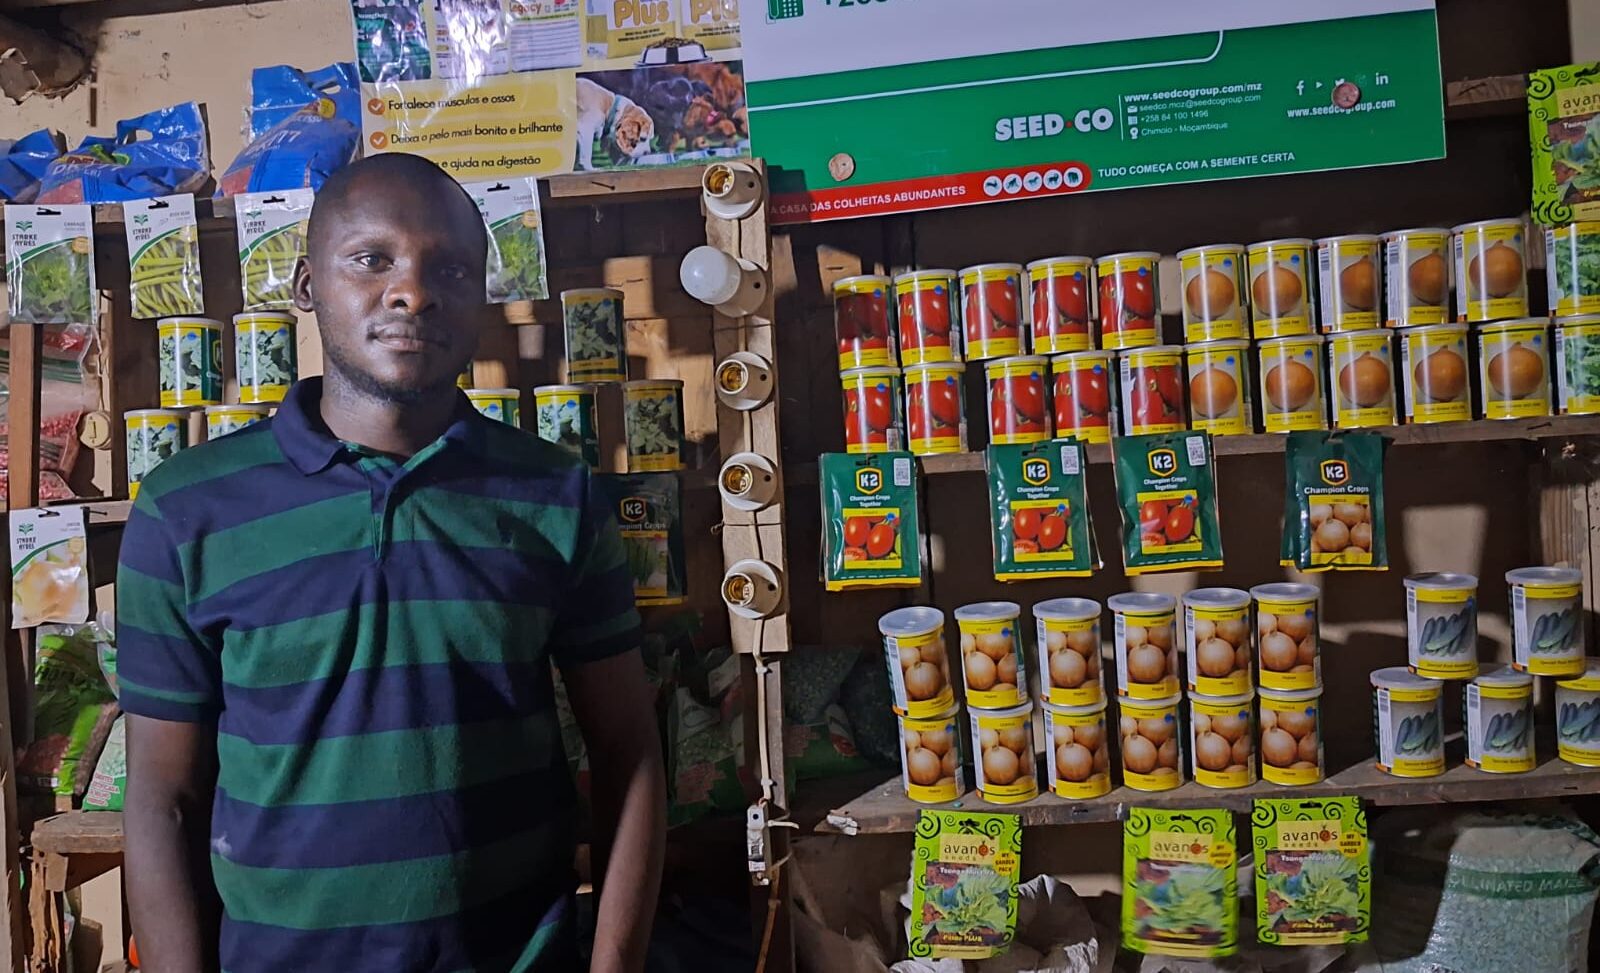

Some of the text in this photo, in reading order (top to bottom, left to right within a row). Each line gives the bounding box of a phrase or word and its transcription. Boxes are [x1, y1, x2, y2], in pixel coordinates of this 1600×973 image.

[613, 0, 669, 28] Plus
[1124, 82, 1262, 103] www.seedcogroup.com/mz
[388, 97, 436, 111] Fortalece
[481, 96, 489, 104] e
[491, 94, 516, 103] ossos
[1563, 94, 1600, 110] avan
[391, 134, 420, 144] Deixa
[429, 129, 450, 144] pelo
[451, 129, 473, 139] mais
[475, 124, 508, 136] bonito
[509, 127, 517, 135] e
[518, 123, 563, 135] brilhante
[441, 160, 448, 168] e
[450, 157, 479, 171] ajuda
[482, 159, 494, 168] na
[497, 155, 541, 170] digestão
[1098, 152, 1295, 178] TUDO COMEÇA COM A SEMENTE CERTA
[780, 203, 808, 214] CASA
[810, 202, 831, 212] DAS
[834, 196, 891, 210] COLHEITAS
[893, 185, 966, 202] ABUNDANTES
[1153, 455, 1173, 469] K2
[1027, 464, 1046, 478] K2
[1326, 466, 1344, 478] K2
[860, 473, 879, 487] K2
[1304, 485, 1369, 494] Champion Crops
[625, 503, 643, 515] K2
[944, 841, 996, 857] avanos
